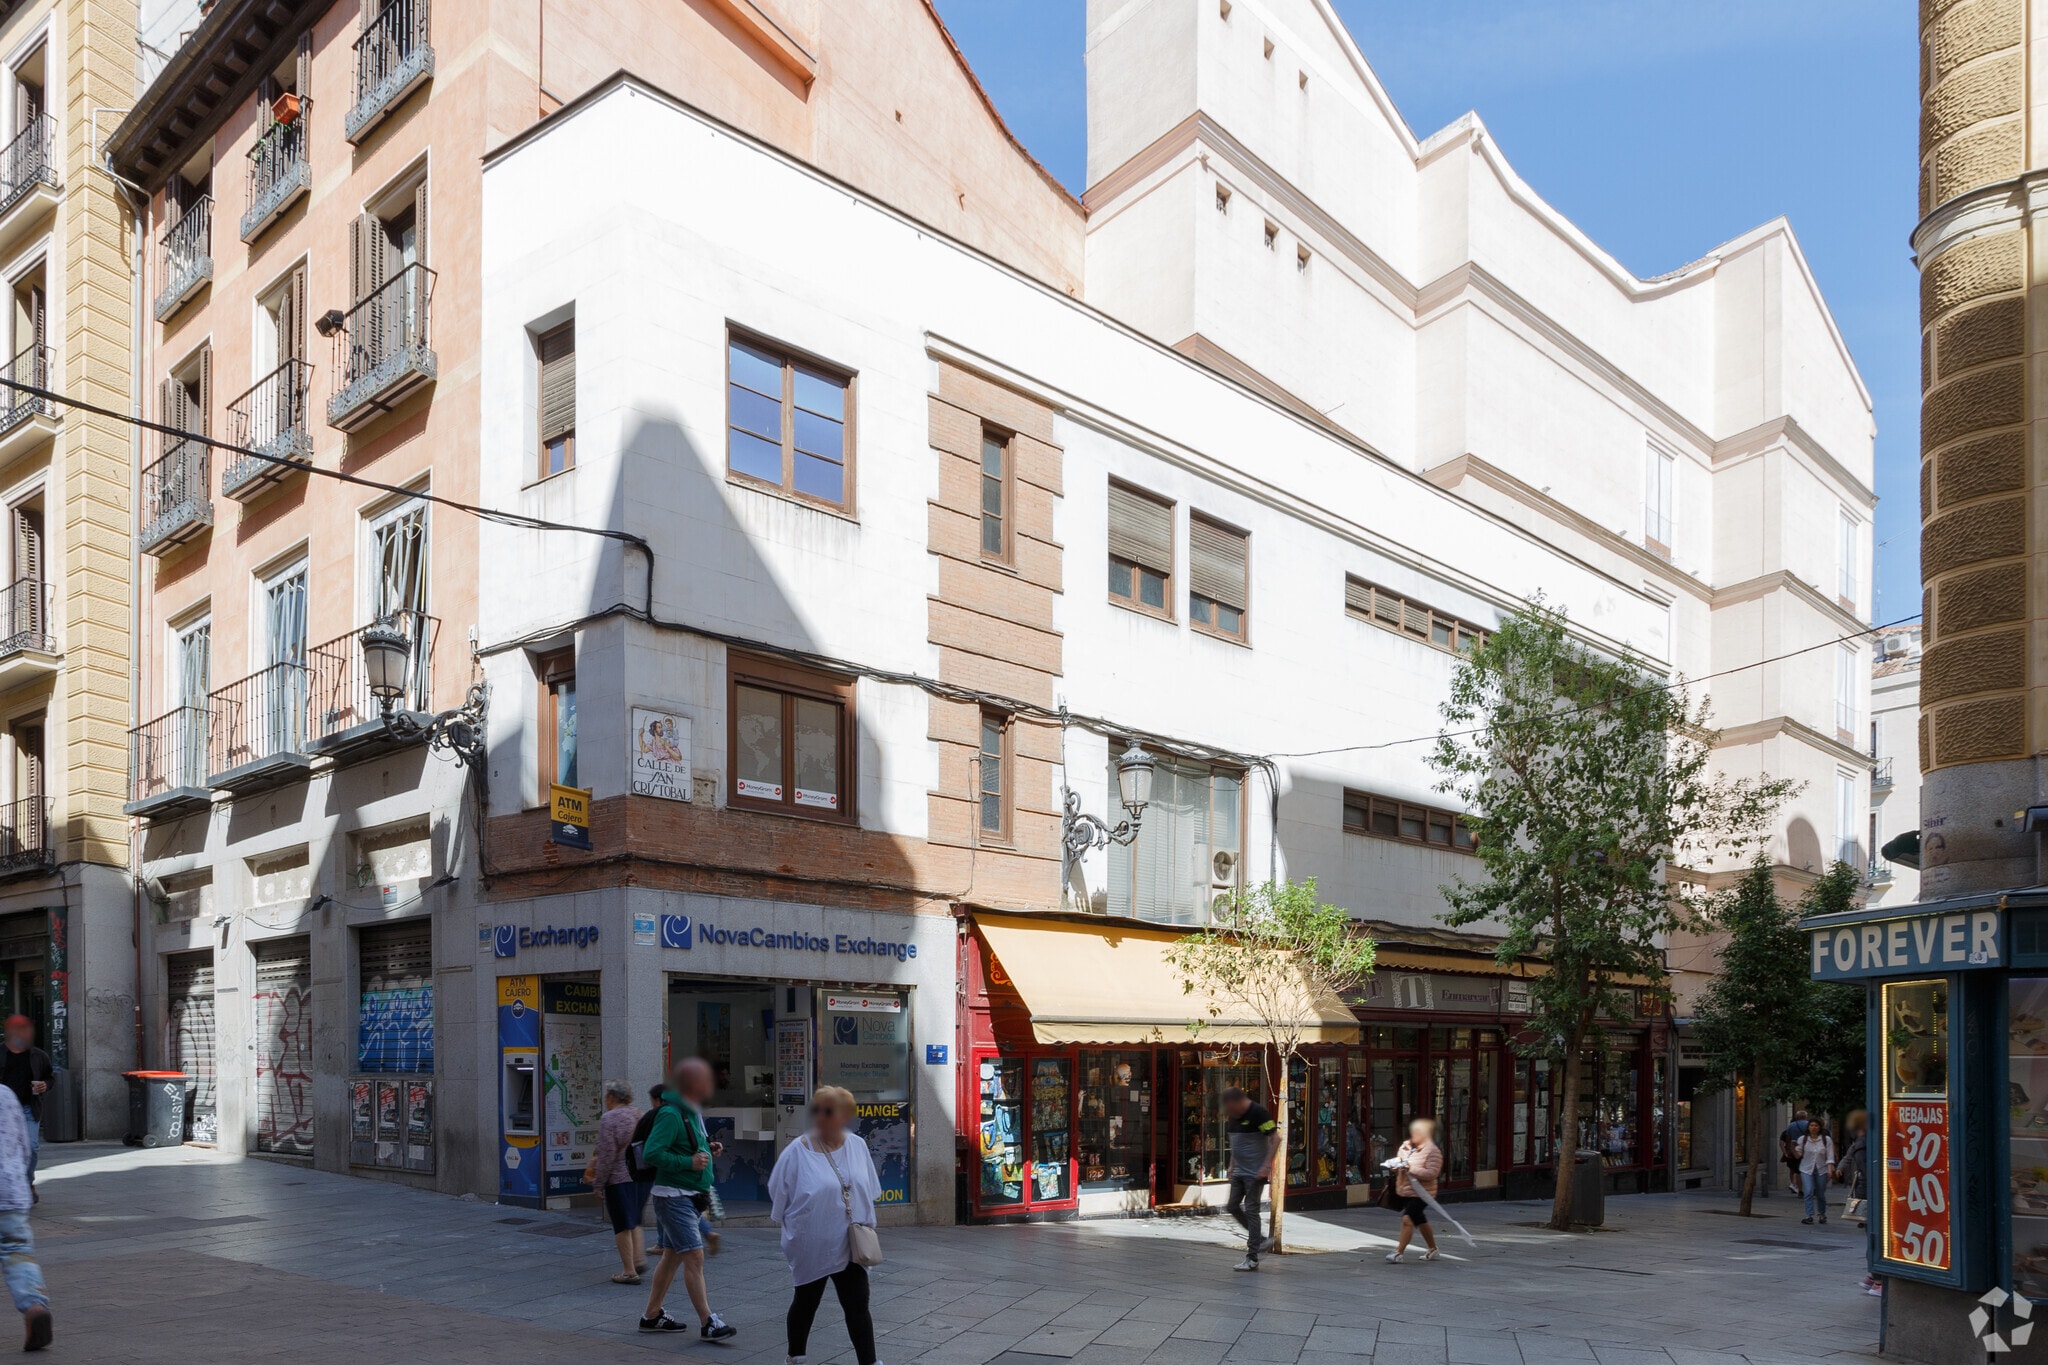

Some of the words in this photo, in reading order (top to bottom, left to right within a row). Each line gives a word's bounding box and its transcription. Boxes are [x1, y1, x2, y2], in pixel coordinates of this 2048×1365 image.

[637, 757, 673, 773] CALLE
[674, 765, 687, 775] DE
[649, 771, 674, 785] SAN
[633, 780, 691, 801] CRISTOBAL
[557, 796, 582, 812] ATM
[557, 810, 583, 824] Cajero
[519, 924, 599, 949] Exchange
[699, 922, 830, 953] NovaCambios
[835, 934, 917, 962] Exchange
[1813, 911, 1999, 974] FOREVER
[509, 977, 526, 987] ATM
[1400, 973, 1424, 1008] T
[505, 987, 531, 997] CAJERO
[862, 1017, 895, 1032] Nova
[861, 1062, 890, 1070] Exchange
[1899, 1106, 1943, 1125] REBAJAS
